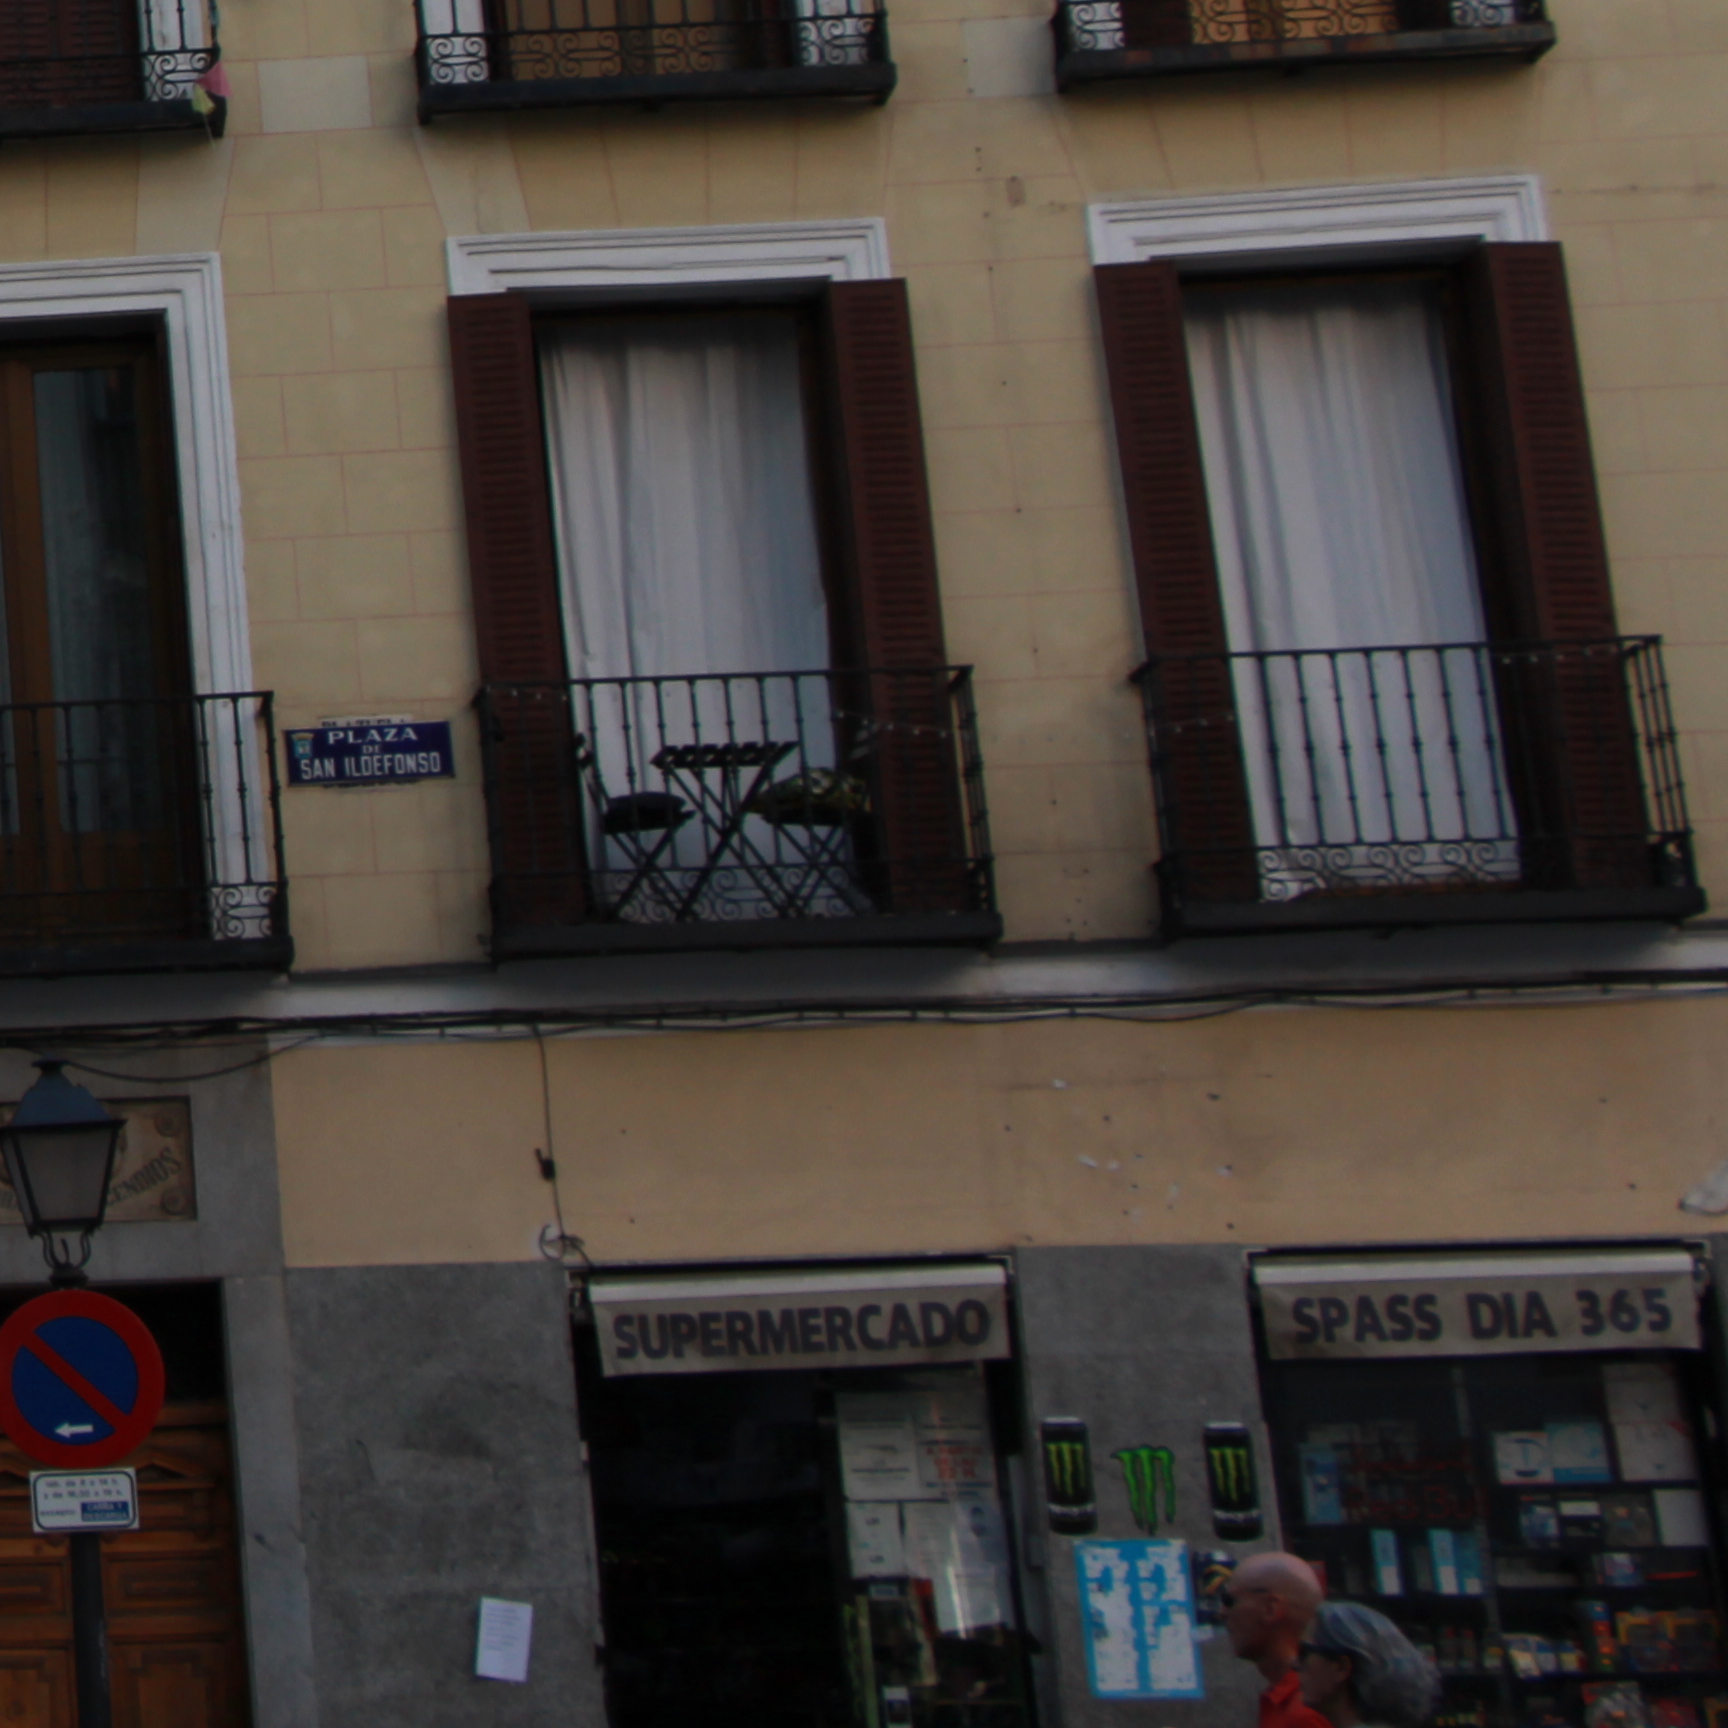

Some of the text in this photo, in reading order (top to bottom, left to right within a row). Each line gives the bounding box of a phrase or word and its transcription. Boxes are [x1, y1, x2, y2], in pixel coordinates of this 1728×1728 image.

[327, 726, 419, 745] PLAZA
[361, 744, 382, 755] DE
[300, 751, 442, 780] SAN ILDEFONSO
[613, 1298, 992, 1360] SUPERMERCADO
[1291, 1287, 1674, 1344] SPASS DIA 365
